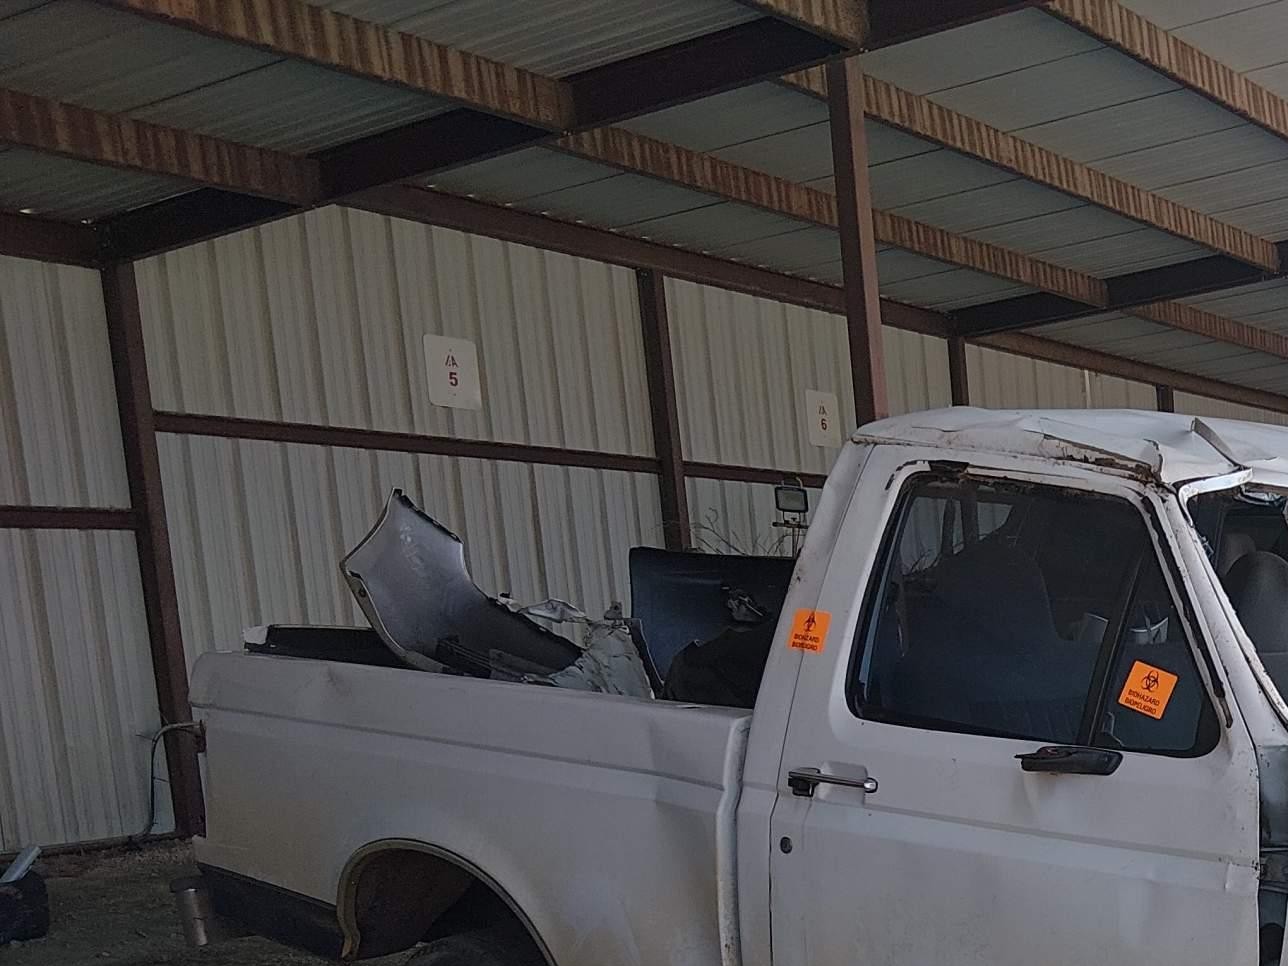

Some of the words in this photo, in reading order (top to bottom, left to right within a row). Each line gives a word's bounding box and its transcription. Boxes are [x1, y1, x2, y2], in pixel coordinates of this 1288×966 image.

[449, 371, 459, 387] 5
[821, 418, 828, 431] 6
[1128, 688, 1161, 706] BIOHAZARD
